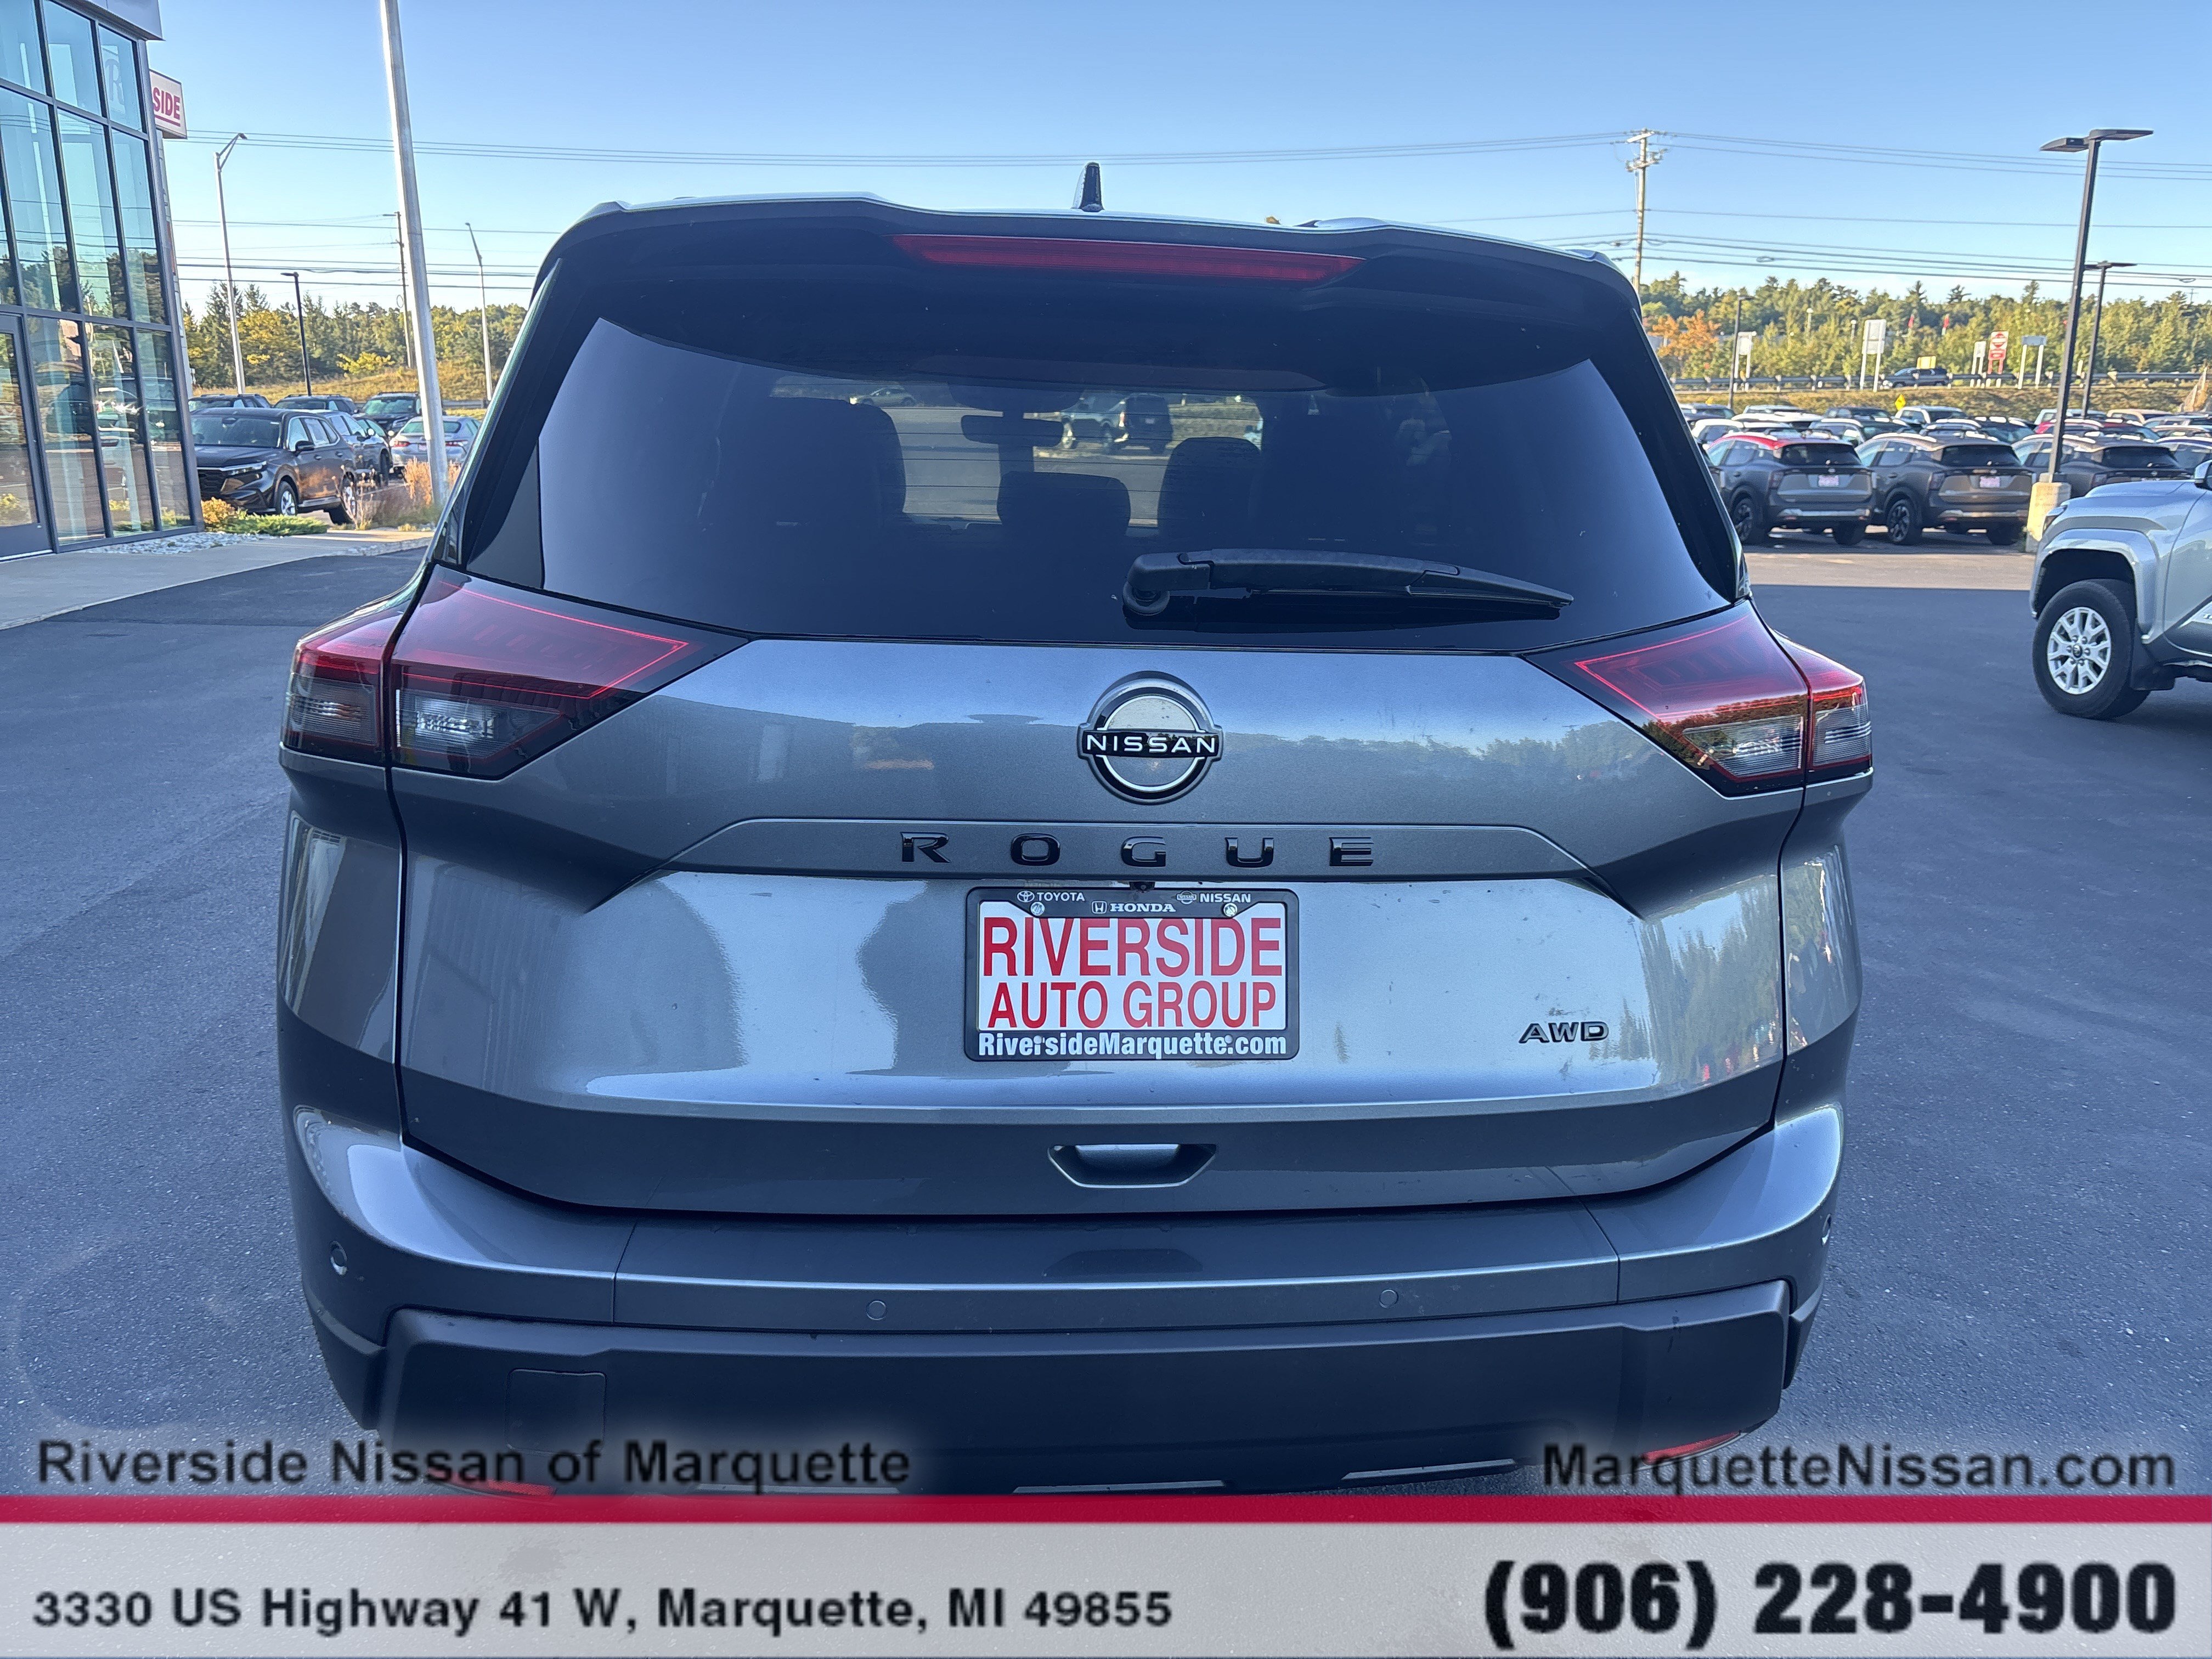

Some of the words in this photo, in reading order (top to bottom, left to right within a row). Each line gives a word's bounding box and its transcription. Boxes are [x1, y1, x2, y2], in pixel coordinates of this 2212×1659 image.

[1086, 734, 1216, 754] NISSAN
[900, 831, 1375, 868] ROGUE
[1036, 892, 1085, 902] TOYOTA
[1199, 893, 1251, 903] NISSAN
[1109, 902, 1176, 913] HONDA
[983, 917, 1283, 977] RIVERSIDE
[988, 981, 1108, 1028] AUTO
[1122, 980, 1276, 1028] GROUP
[1518, 1021, 1609, 1043] AWD
[979, 1032, 1286, 1059] RiversideMarquette.com
